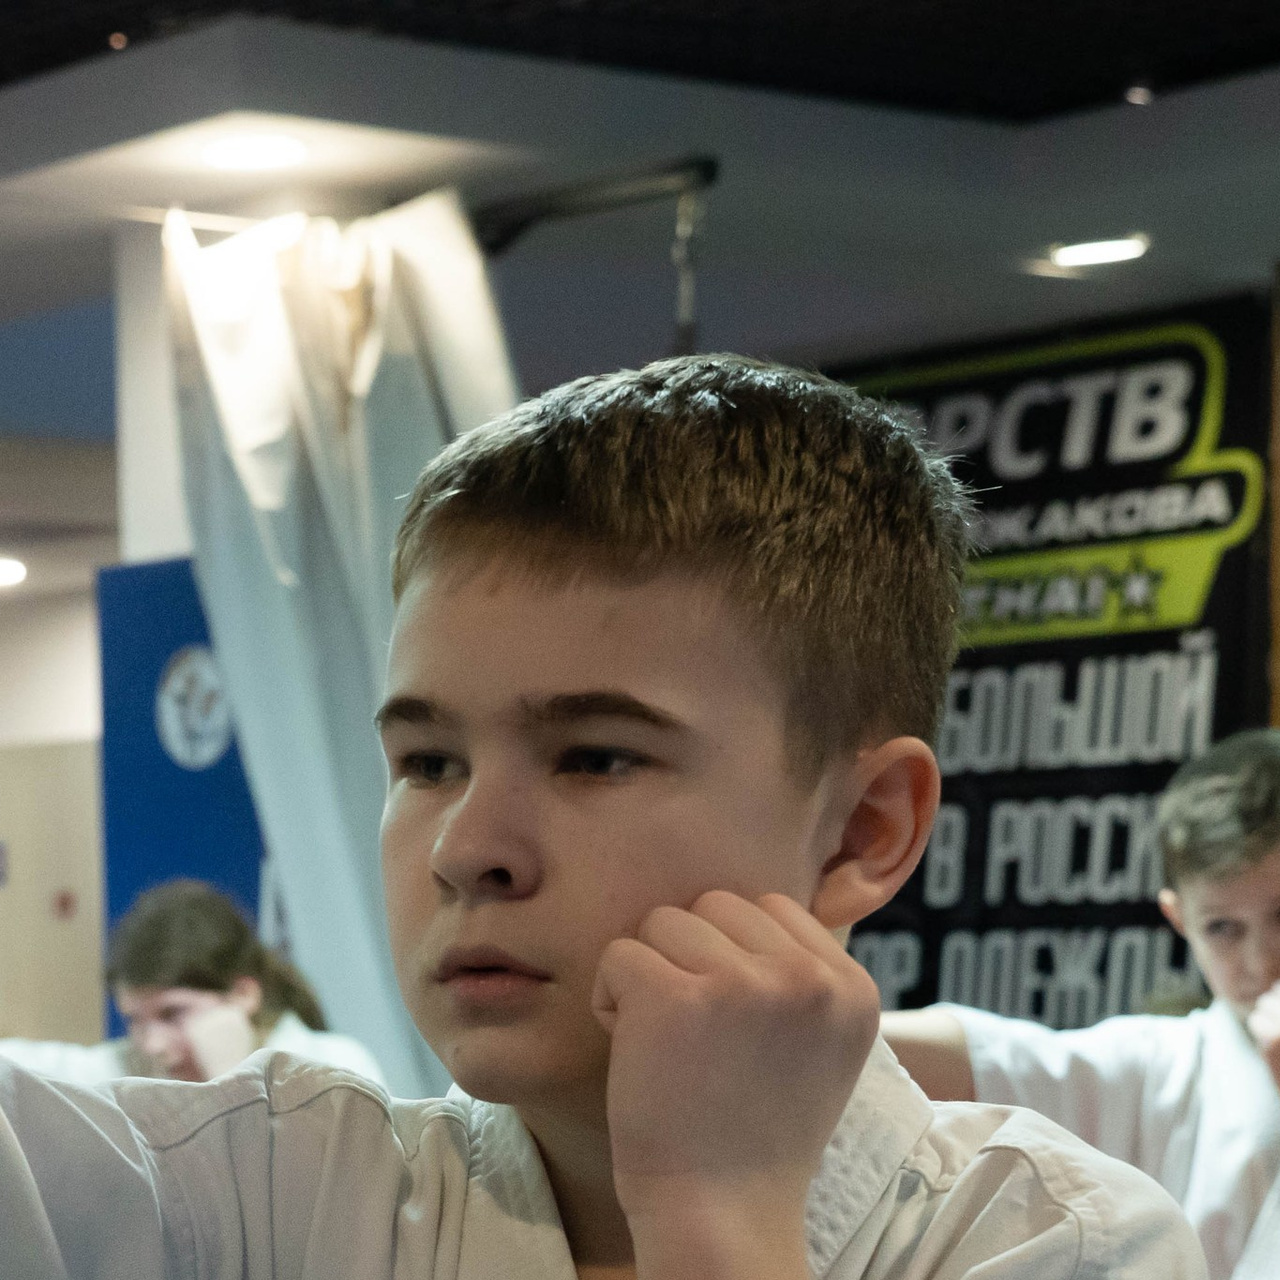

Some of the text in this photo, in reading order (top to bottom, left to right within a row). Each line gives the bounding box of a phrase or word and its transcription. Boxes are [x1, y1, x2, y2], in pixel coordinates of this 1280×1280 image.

[906, 360, 1197, 482] РСТВ
[968, 477, 1233, 549] ЖАКОВА
[941, 627, 1216, 778] БОЛЬШОЙ
[923, 792, 1166, 909] В РОССИ
